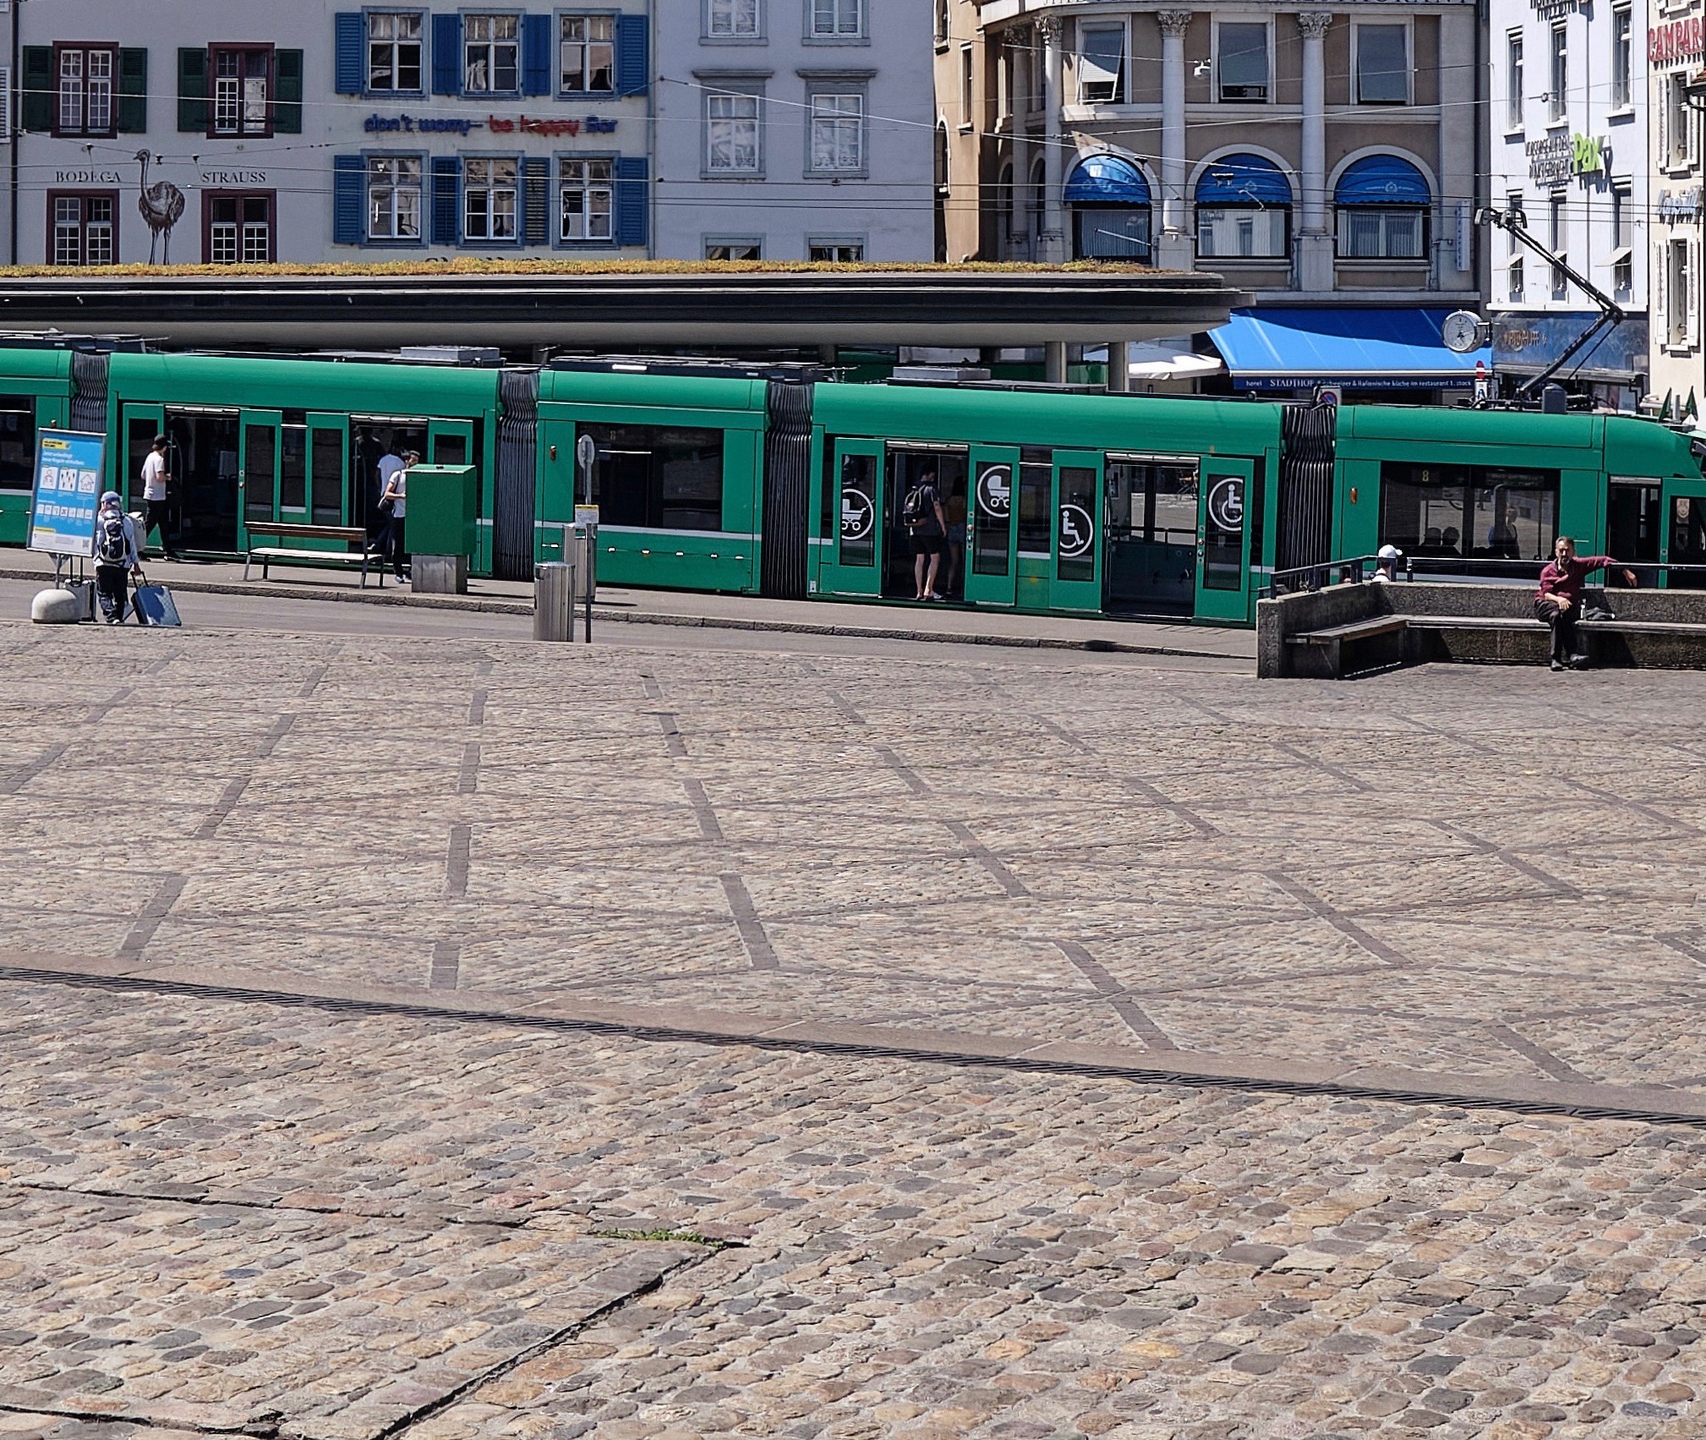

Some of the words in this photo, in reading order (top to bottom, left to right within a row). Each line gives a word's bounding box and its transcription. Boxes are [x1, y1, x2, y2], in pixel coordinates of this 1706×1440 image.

[364, 113, 414, 133] don't
[489, 114, 514, 133] be
[520, 114, 580, 137] happy
[1573, 131, 1602, 174] Pax
[55, 171, 121, 183] BODEGA
[202, 171, 267, 183] STRAUSS
[1270, 379, 1314, 387] STADTHOF
[1422, 471, 1429, 482] 8
